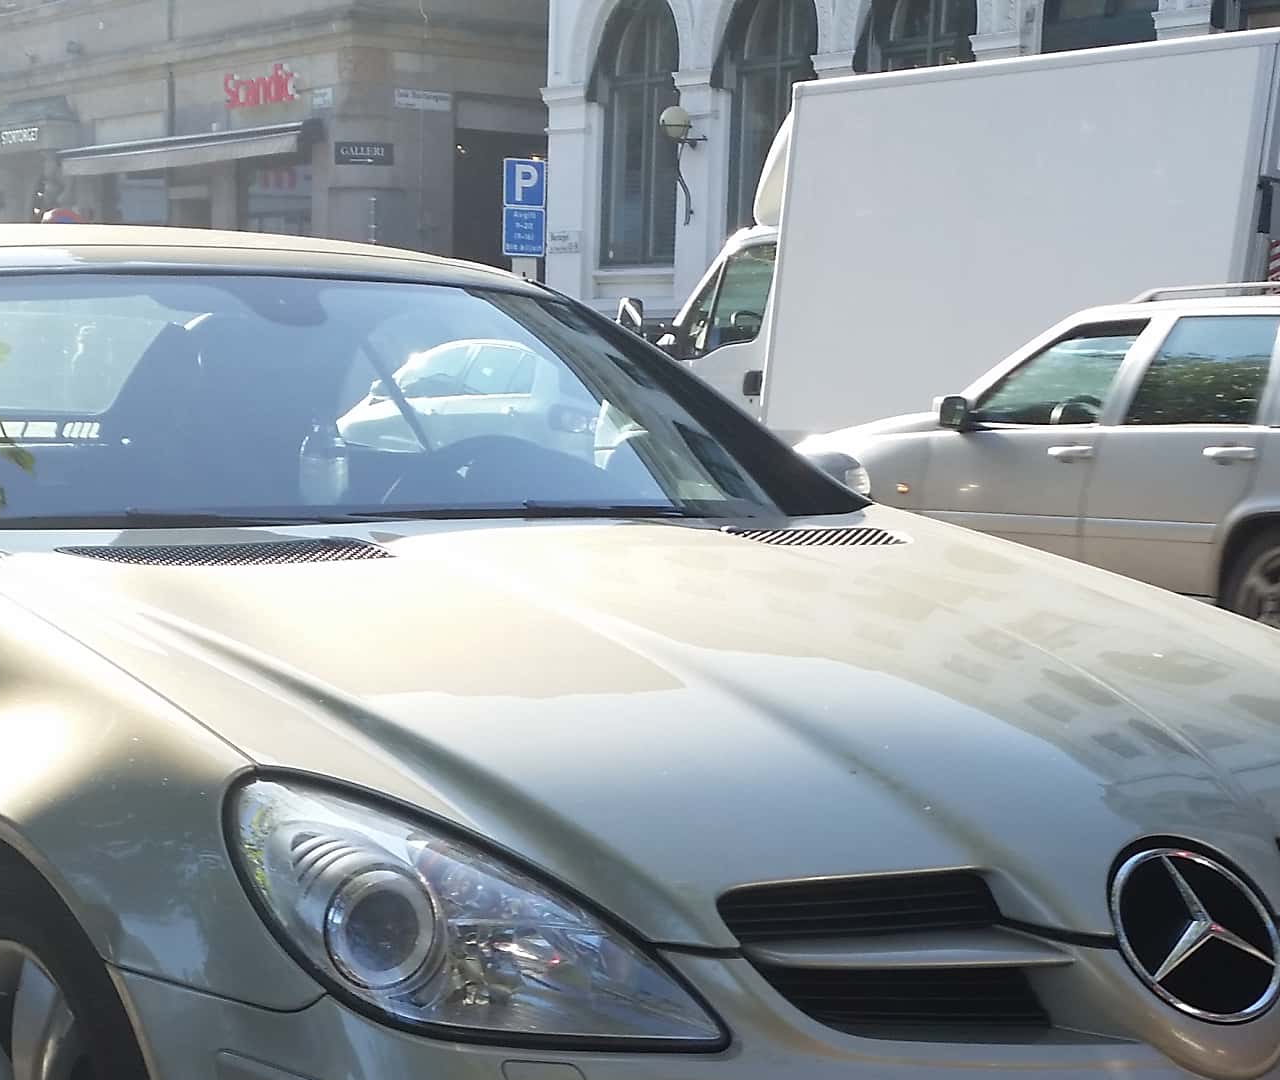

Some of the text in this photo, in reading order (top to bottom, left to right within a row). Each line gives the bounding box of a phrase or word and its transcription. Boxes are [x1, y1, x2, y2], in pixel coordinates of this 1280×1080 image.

[223, 63, 297, 110] Scandic
[340, 146, 384, 156] GALLERI
[515, 164, 538, 201] P
